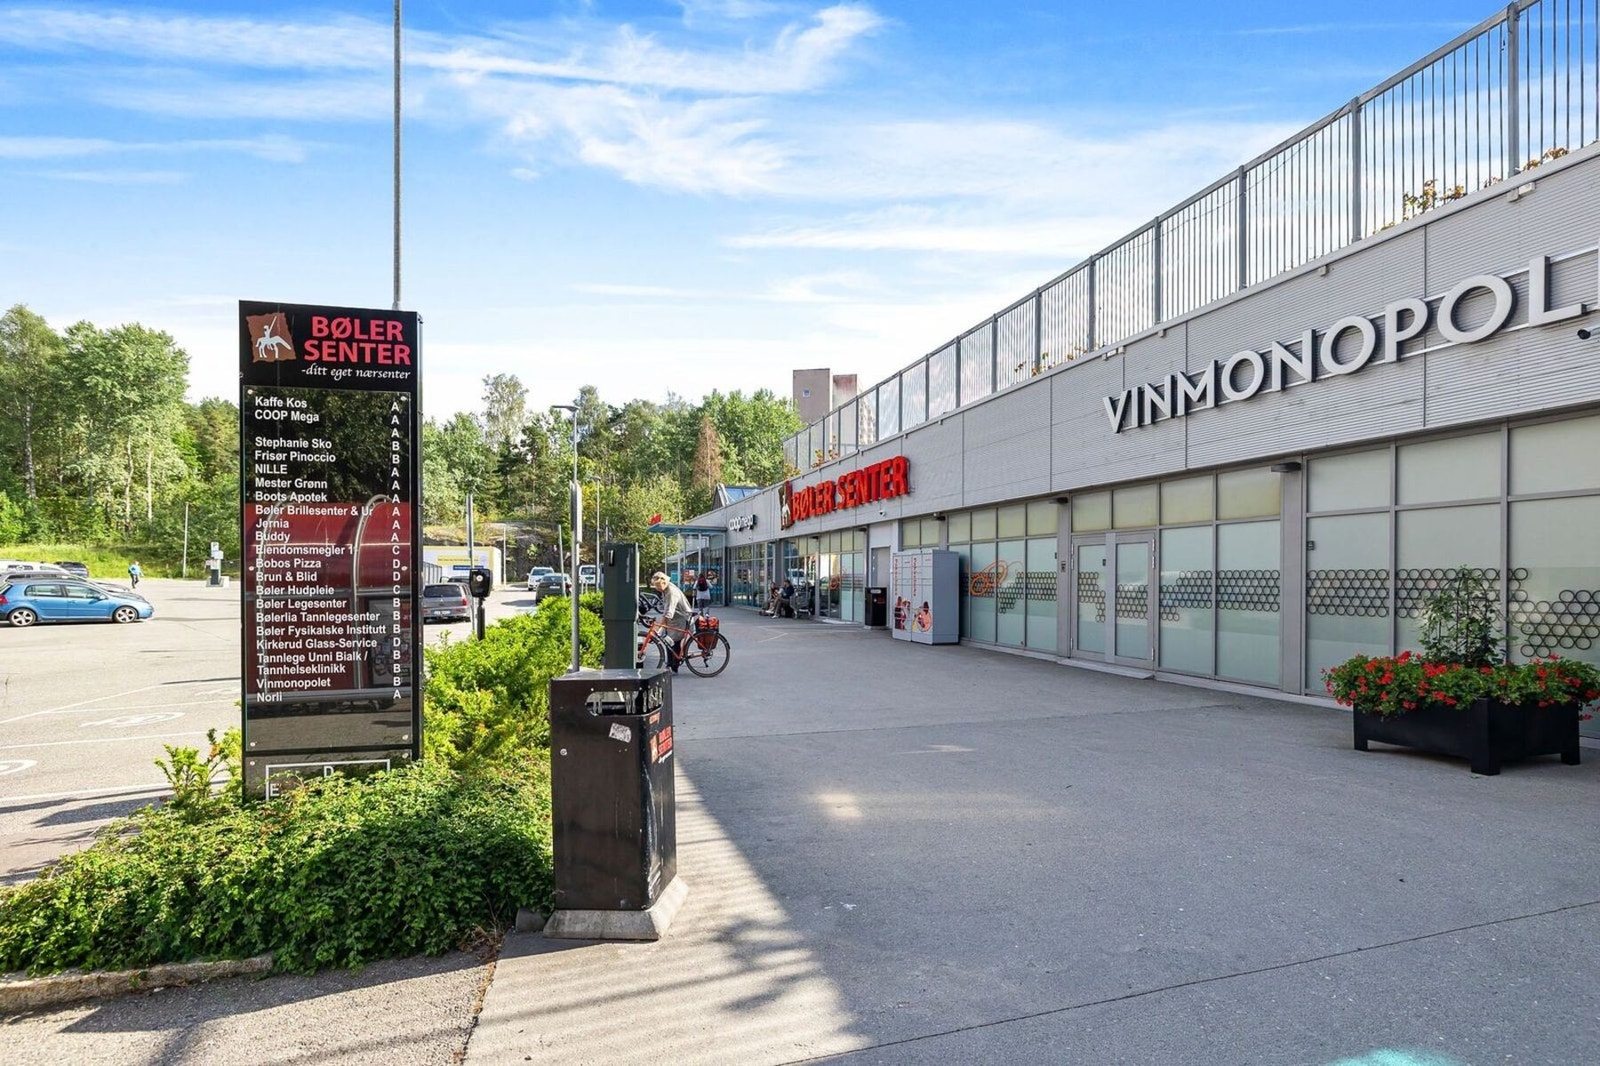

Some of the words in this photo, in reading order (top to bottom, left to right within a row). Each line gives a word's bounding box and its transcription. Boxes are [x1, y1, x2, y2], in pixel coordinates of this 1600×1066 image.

[312, 316, 403, 341] BØLER
[1103, 242, 1600, 433] VINMONOPOL
[304, 340, 411, 365] SENTER
[301, 363, 327, 376] -ditt
[330, 367, 352, 380] eget
[356, 369, 411, 379] nærsenter
[255, 397, 283, 407] Kaffe
[287, 398, 307, 408] Kos
[392, 402, 400, 411] A
[255, 410, 287, 420] COOP
[291, 411, 319, 423] Mega
[392, 415, 400, 424] A
[392, 428, 400, 437] A
[256, 437, 308, 449] Stephanie
[312, 438, 332, 449] Sko
[392, 441, 400, 450] B
[255, 451, 286, 461] Frisør
[290, 452, 336, 462] Pinoccio
[392, 454, 400, 463] B
[255, 465, 287, 474] NILLE
[392, 468, 400, 477] A
[256, 478, 291, 488] Mester
[295, 479, 327, 489] Grønn
[392, 481, 400, 489] A
[792, 480, 836, 522] BØLER
[836, 456, 910, 510] SENTER
[256, 492, 287, 501] Boots
[290, 492, 327, 503] Apotek
[392, 494, 400, 503] A
[256, 505, 286, 514] Bøler
[288, 505, 347, 516] Brillesenter
[351, 506, 358, 516] &
[392, 507, 400, 516] A
[256, 518, 289, 528] Jernia
[392, 520, 400, 529] A
[256, 532, 290, 543] Buddy
[392, 533, 400, 541] A
[392, 546, 400, 554] C
[256, 559, 290, 568] Bobos
[294, 559, 321, 568] Pizza
[393, 559, 401, 568] D
[256, 572, 282, 582] Brun
[285, 572, 293, 582] &
[297, 572, 317, 582] Blid
[393, 572, 401, 581] D
[257, 586, 285, 595] Bøler
[288, 585, 334, 597] Hudpleie
[393, 585, 401, 594] C
[257, 599, 285, 609] Bøler
[288, 598, 347, 610] Legesenter
[393, 598, 401, 607] B
[257, 612, 297, 623] Bølerlia
[300, 612, 380, 623] Tannlegesenter
[393, 611, 401, 620] B
[257, 626, 285, 636] Bøler
[288, 625, 344, 637] Fysikalske
[347, 624, 386, 634] Institutt
[393, 625, 401, 633] B
[257, 639, 302, 649] Kirkerud
[305, 638, 377, 648] Glass-Service
[393, 638, 401, 647] D
[257, 653, 305, 664] Tannlege
[308, 652, 333, 662] Unni
[336, 651, 361, 661] Bialk
[364, 651, 368, 661] /
[393, 651, 401, 660] B
[257, 665, 346, 675] Tannhelseklinikk
[393, 664, 401, 673] B
[257, 678, 331, 690] Vinmonopolet
[393, 678, 401, 686] B
[257, 692, 282, 702] Norli
[393, 690, 401, 699] A
[269, 784, 279, 797] E
